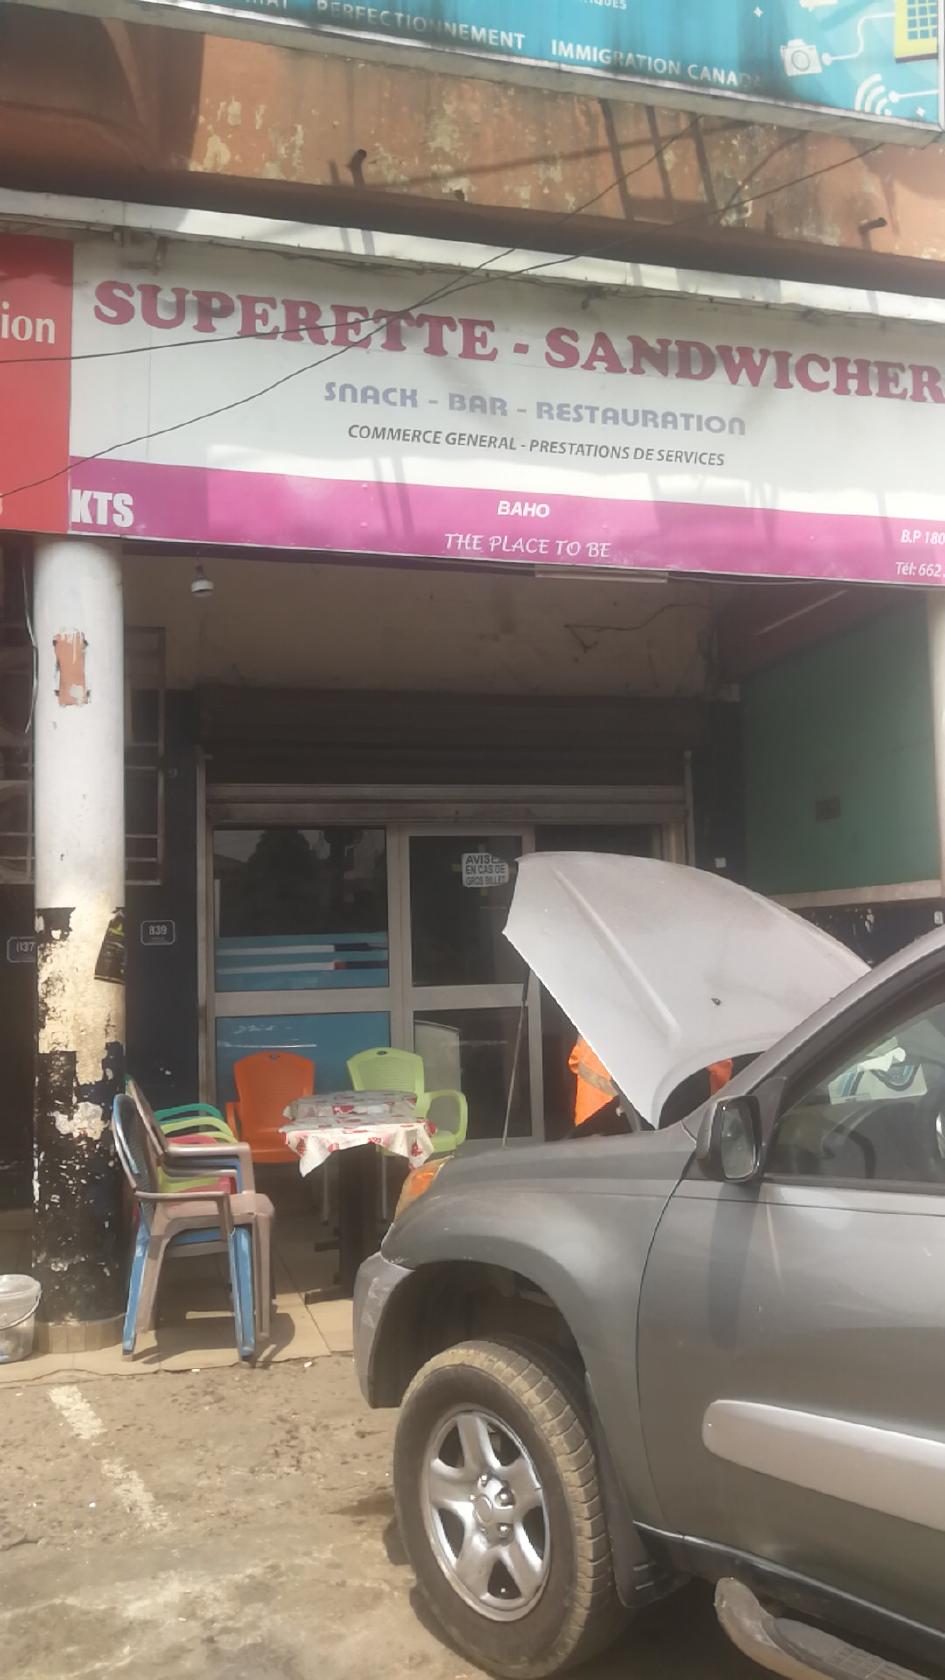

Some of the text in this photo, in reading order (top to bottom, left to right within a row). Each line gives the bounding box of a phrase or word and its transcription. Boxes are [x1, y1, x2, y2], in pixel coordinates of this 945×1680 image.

[551, 39, 681, 75] IMMIGRATION
[94, 280, 498, 361] SUPERETTE
[324, 381, 418, 408] SNACK
[448, 392, 508, 416] BAR
[536, 400, 746, 435] RESTAURATION
[348, 424, 443, 445] COMMERCE
[445, 431, 518, 451] GENERAL
[528, 439, 630, 460] PRESTATIONS
[633, 446, 655, 461] DE
[656, 449, 725, 467] SERVICES
[71, 488, 134, 528] KTS
[497, 500, 550, 518] BAHO
[444, 533, 612, 558] THE PLACE TO BE
[465, 864, 476, 874] EN
